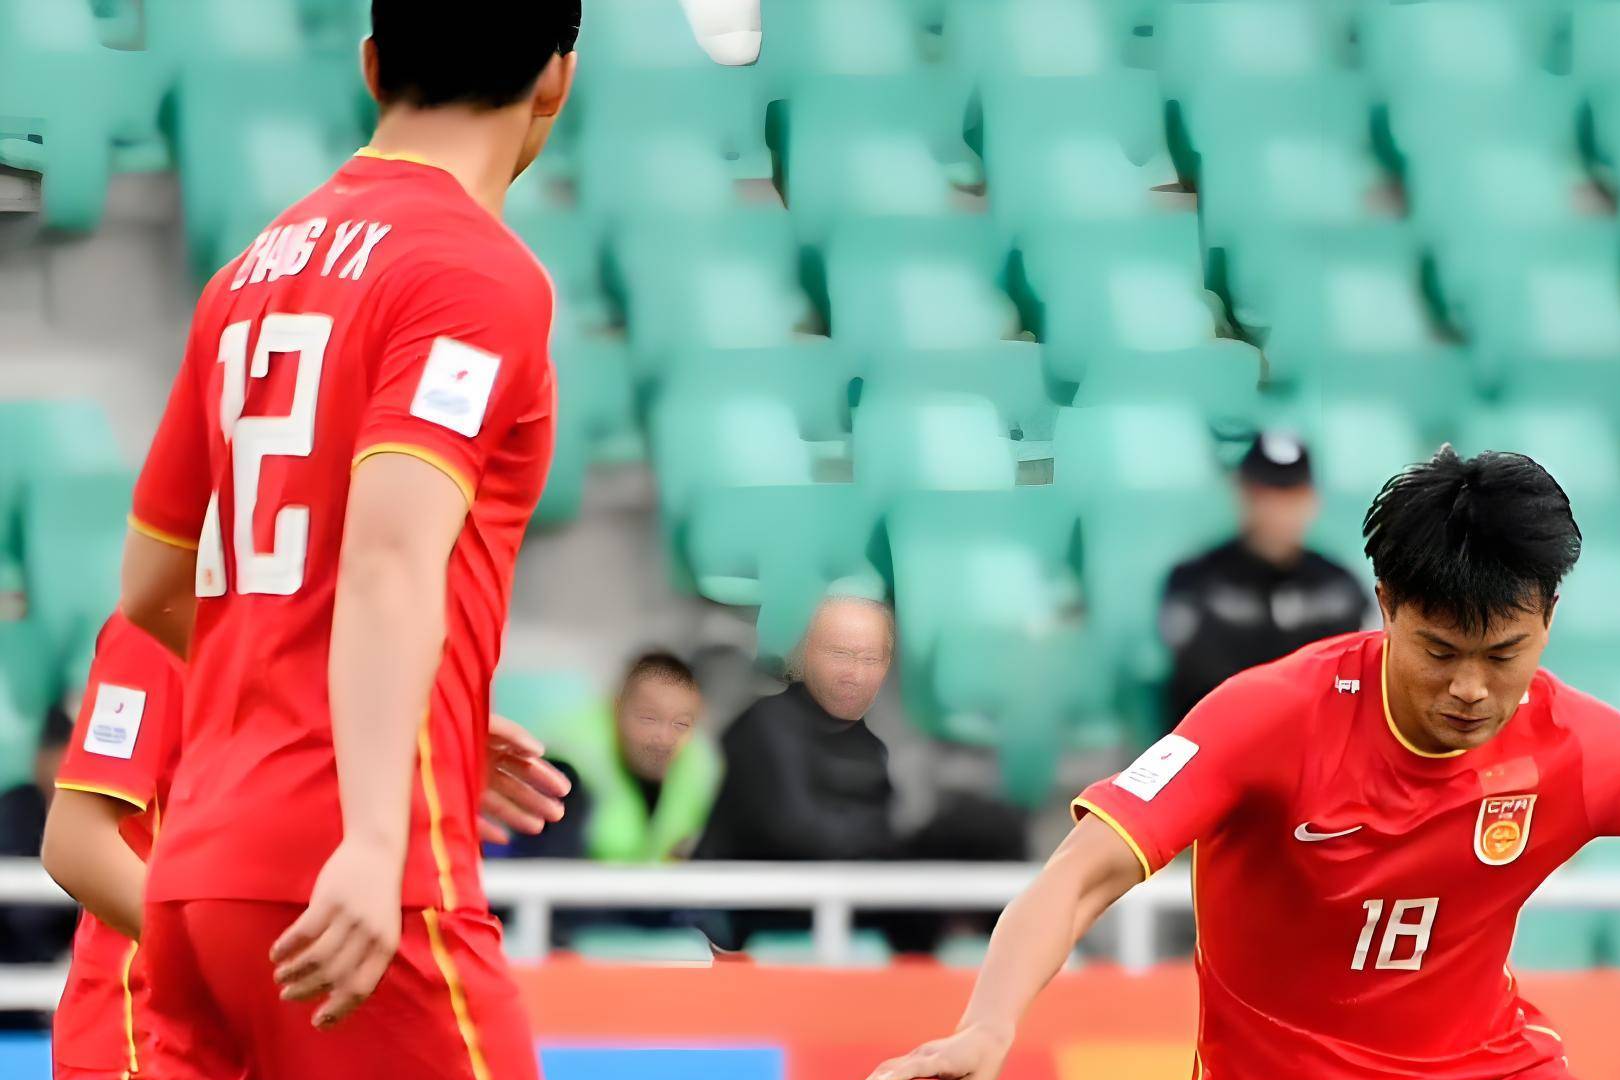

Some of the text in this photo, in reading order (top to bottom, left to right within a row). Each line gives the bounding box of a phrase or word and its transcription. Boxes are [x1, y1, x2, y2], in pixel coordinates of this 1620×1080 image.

[320, 219, 393, 281] YX
[195, 312, 334, 597] 12
[1350, 897, 1440, 971] 18
